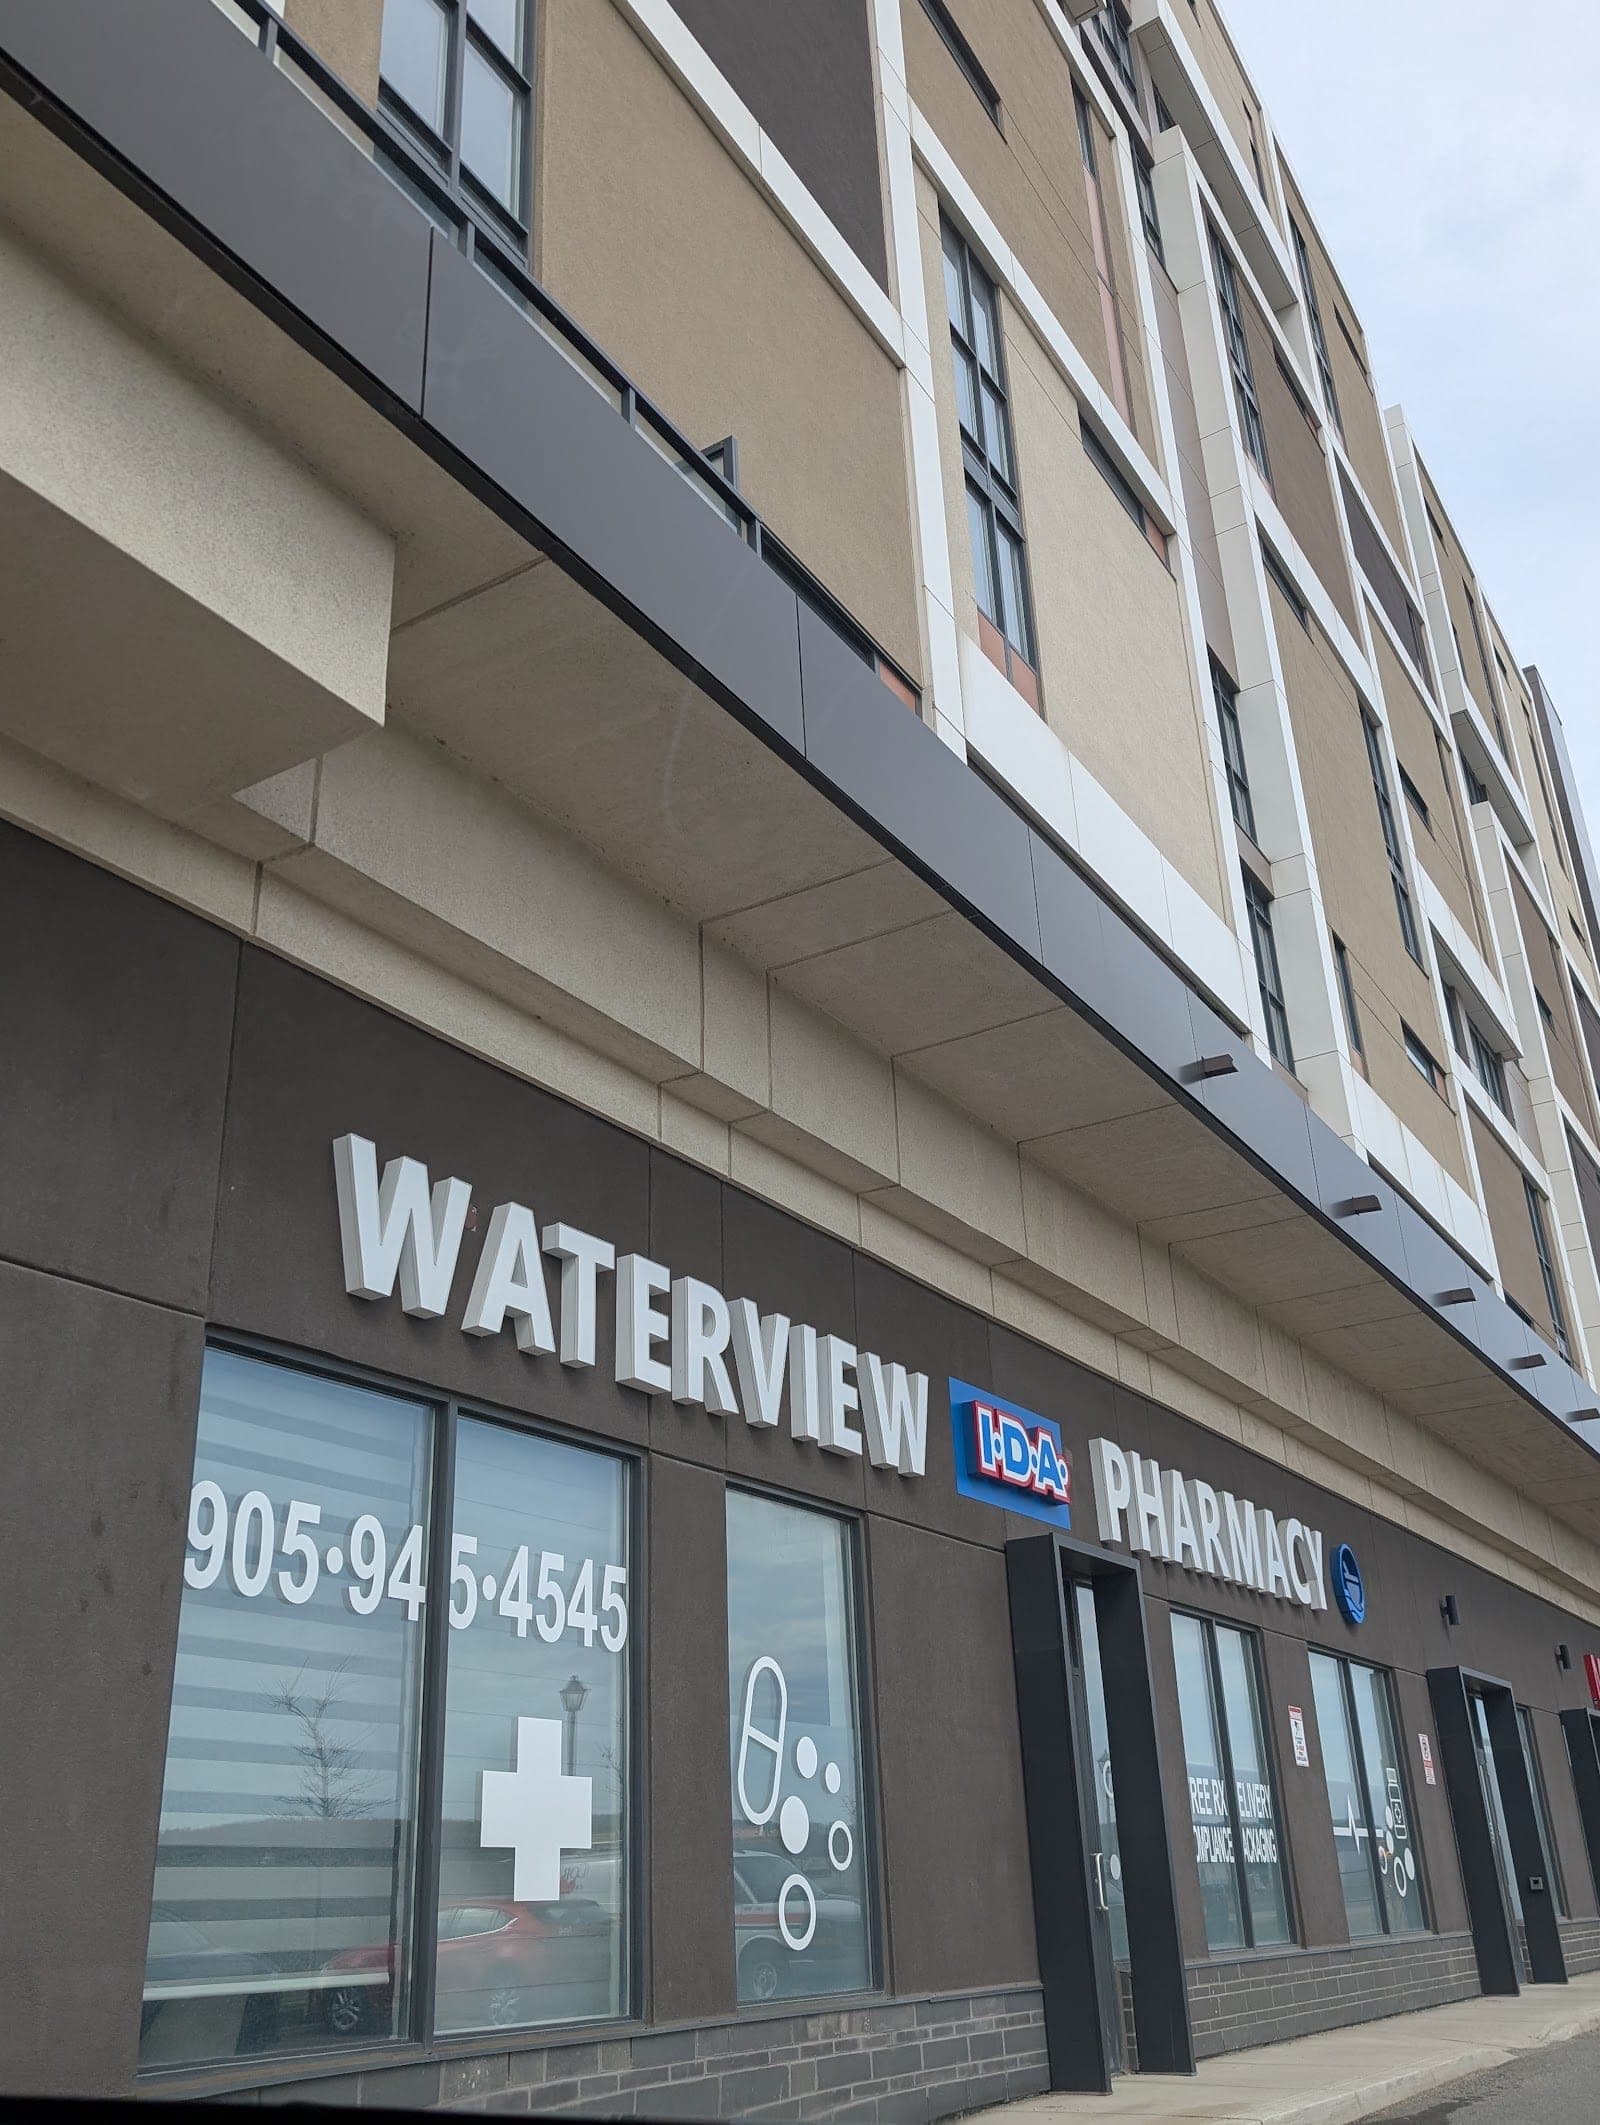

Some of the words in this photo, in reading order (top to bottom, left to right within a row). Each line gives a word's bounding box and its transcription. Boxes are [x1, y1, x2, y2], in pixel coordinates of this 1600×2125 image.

[332, 1132, 929, 1479] WATERVIEW
[1088, 1437, 1328, 1610] PHARMACY
[1188, 1776, 1212, 1815] REE
[1212, 1778, 1229, 1816] RX
[1236, 1781, 1273, 1819] ELIVERY
[1242, 1827, 1278, 1863] ACKAGING
